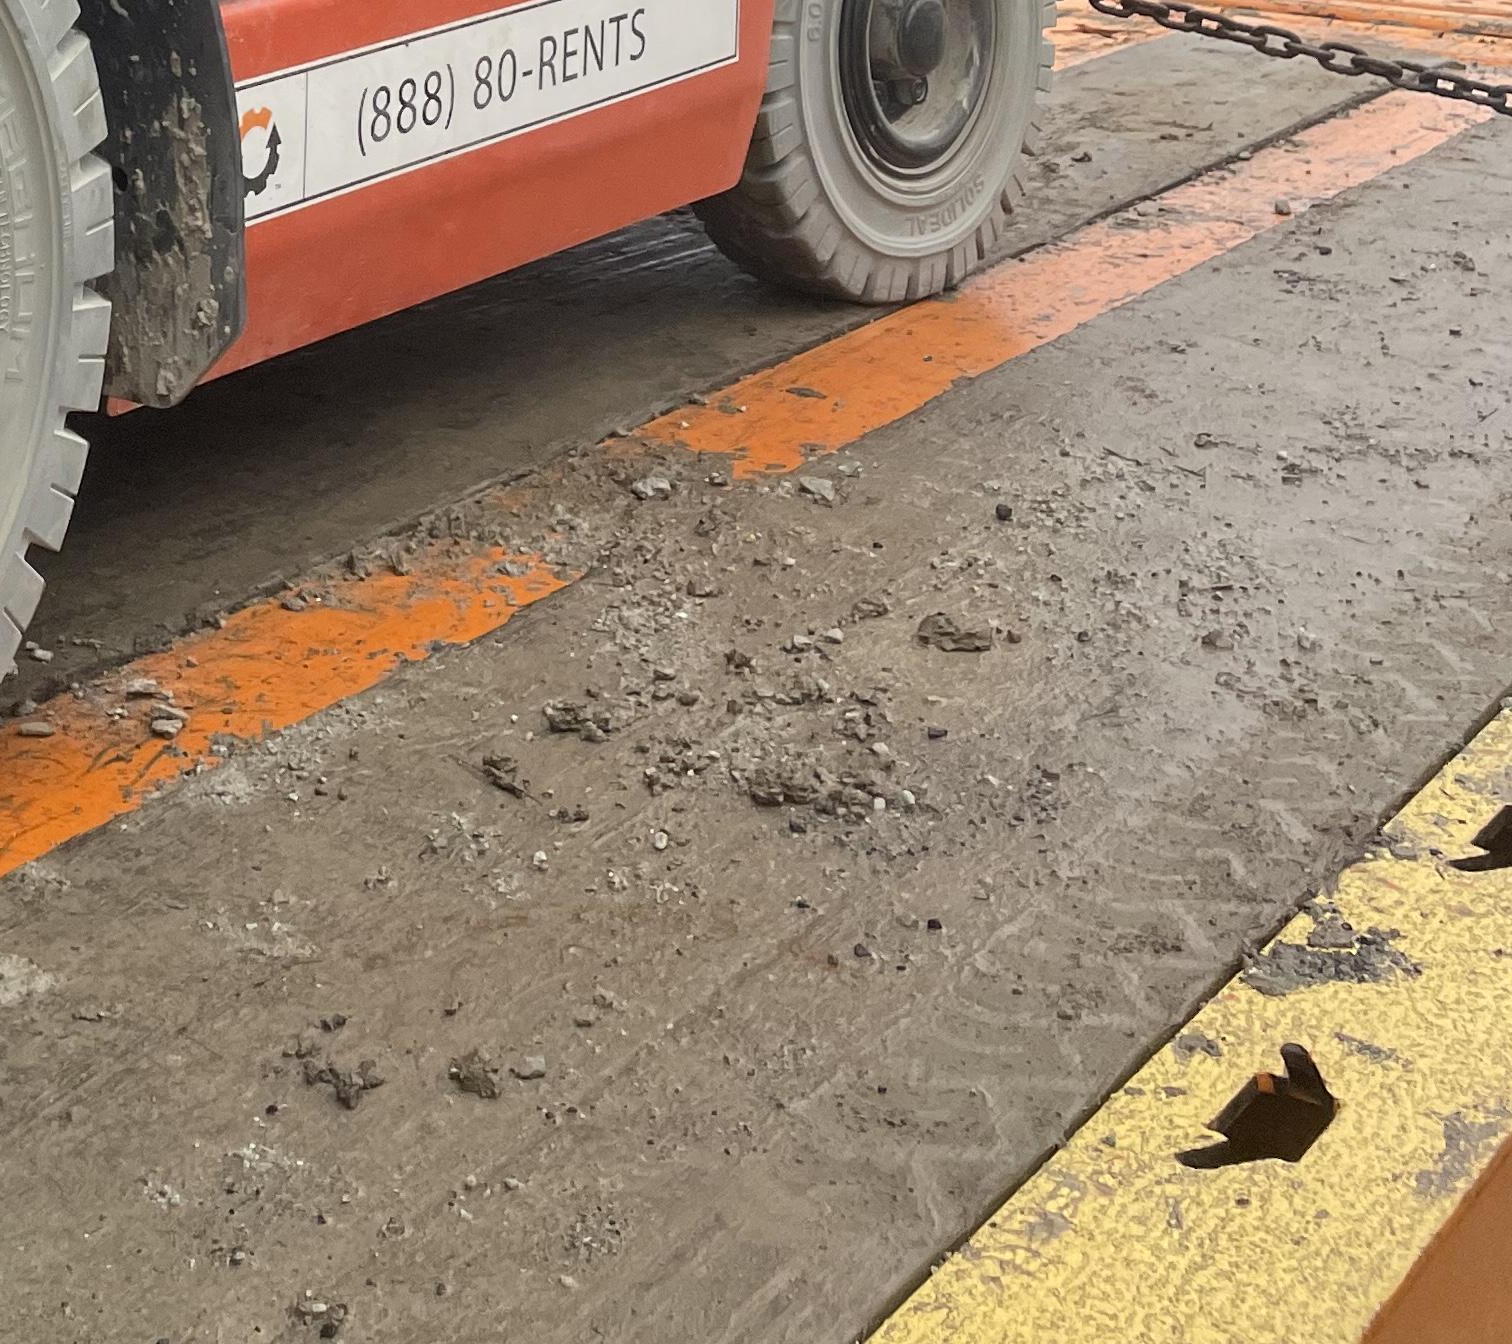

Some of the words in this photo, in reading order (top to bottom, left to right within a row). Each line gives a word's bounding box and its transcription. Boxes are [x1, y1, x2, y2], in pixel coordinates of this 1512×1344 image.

[356, 63, 455, 157] (888)
[472, 8, 647, 110] 80-RENTS
[904, 173, 985, 237] SOLIDEAL
